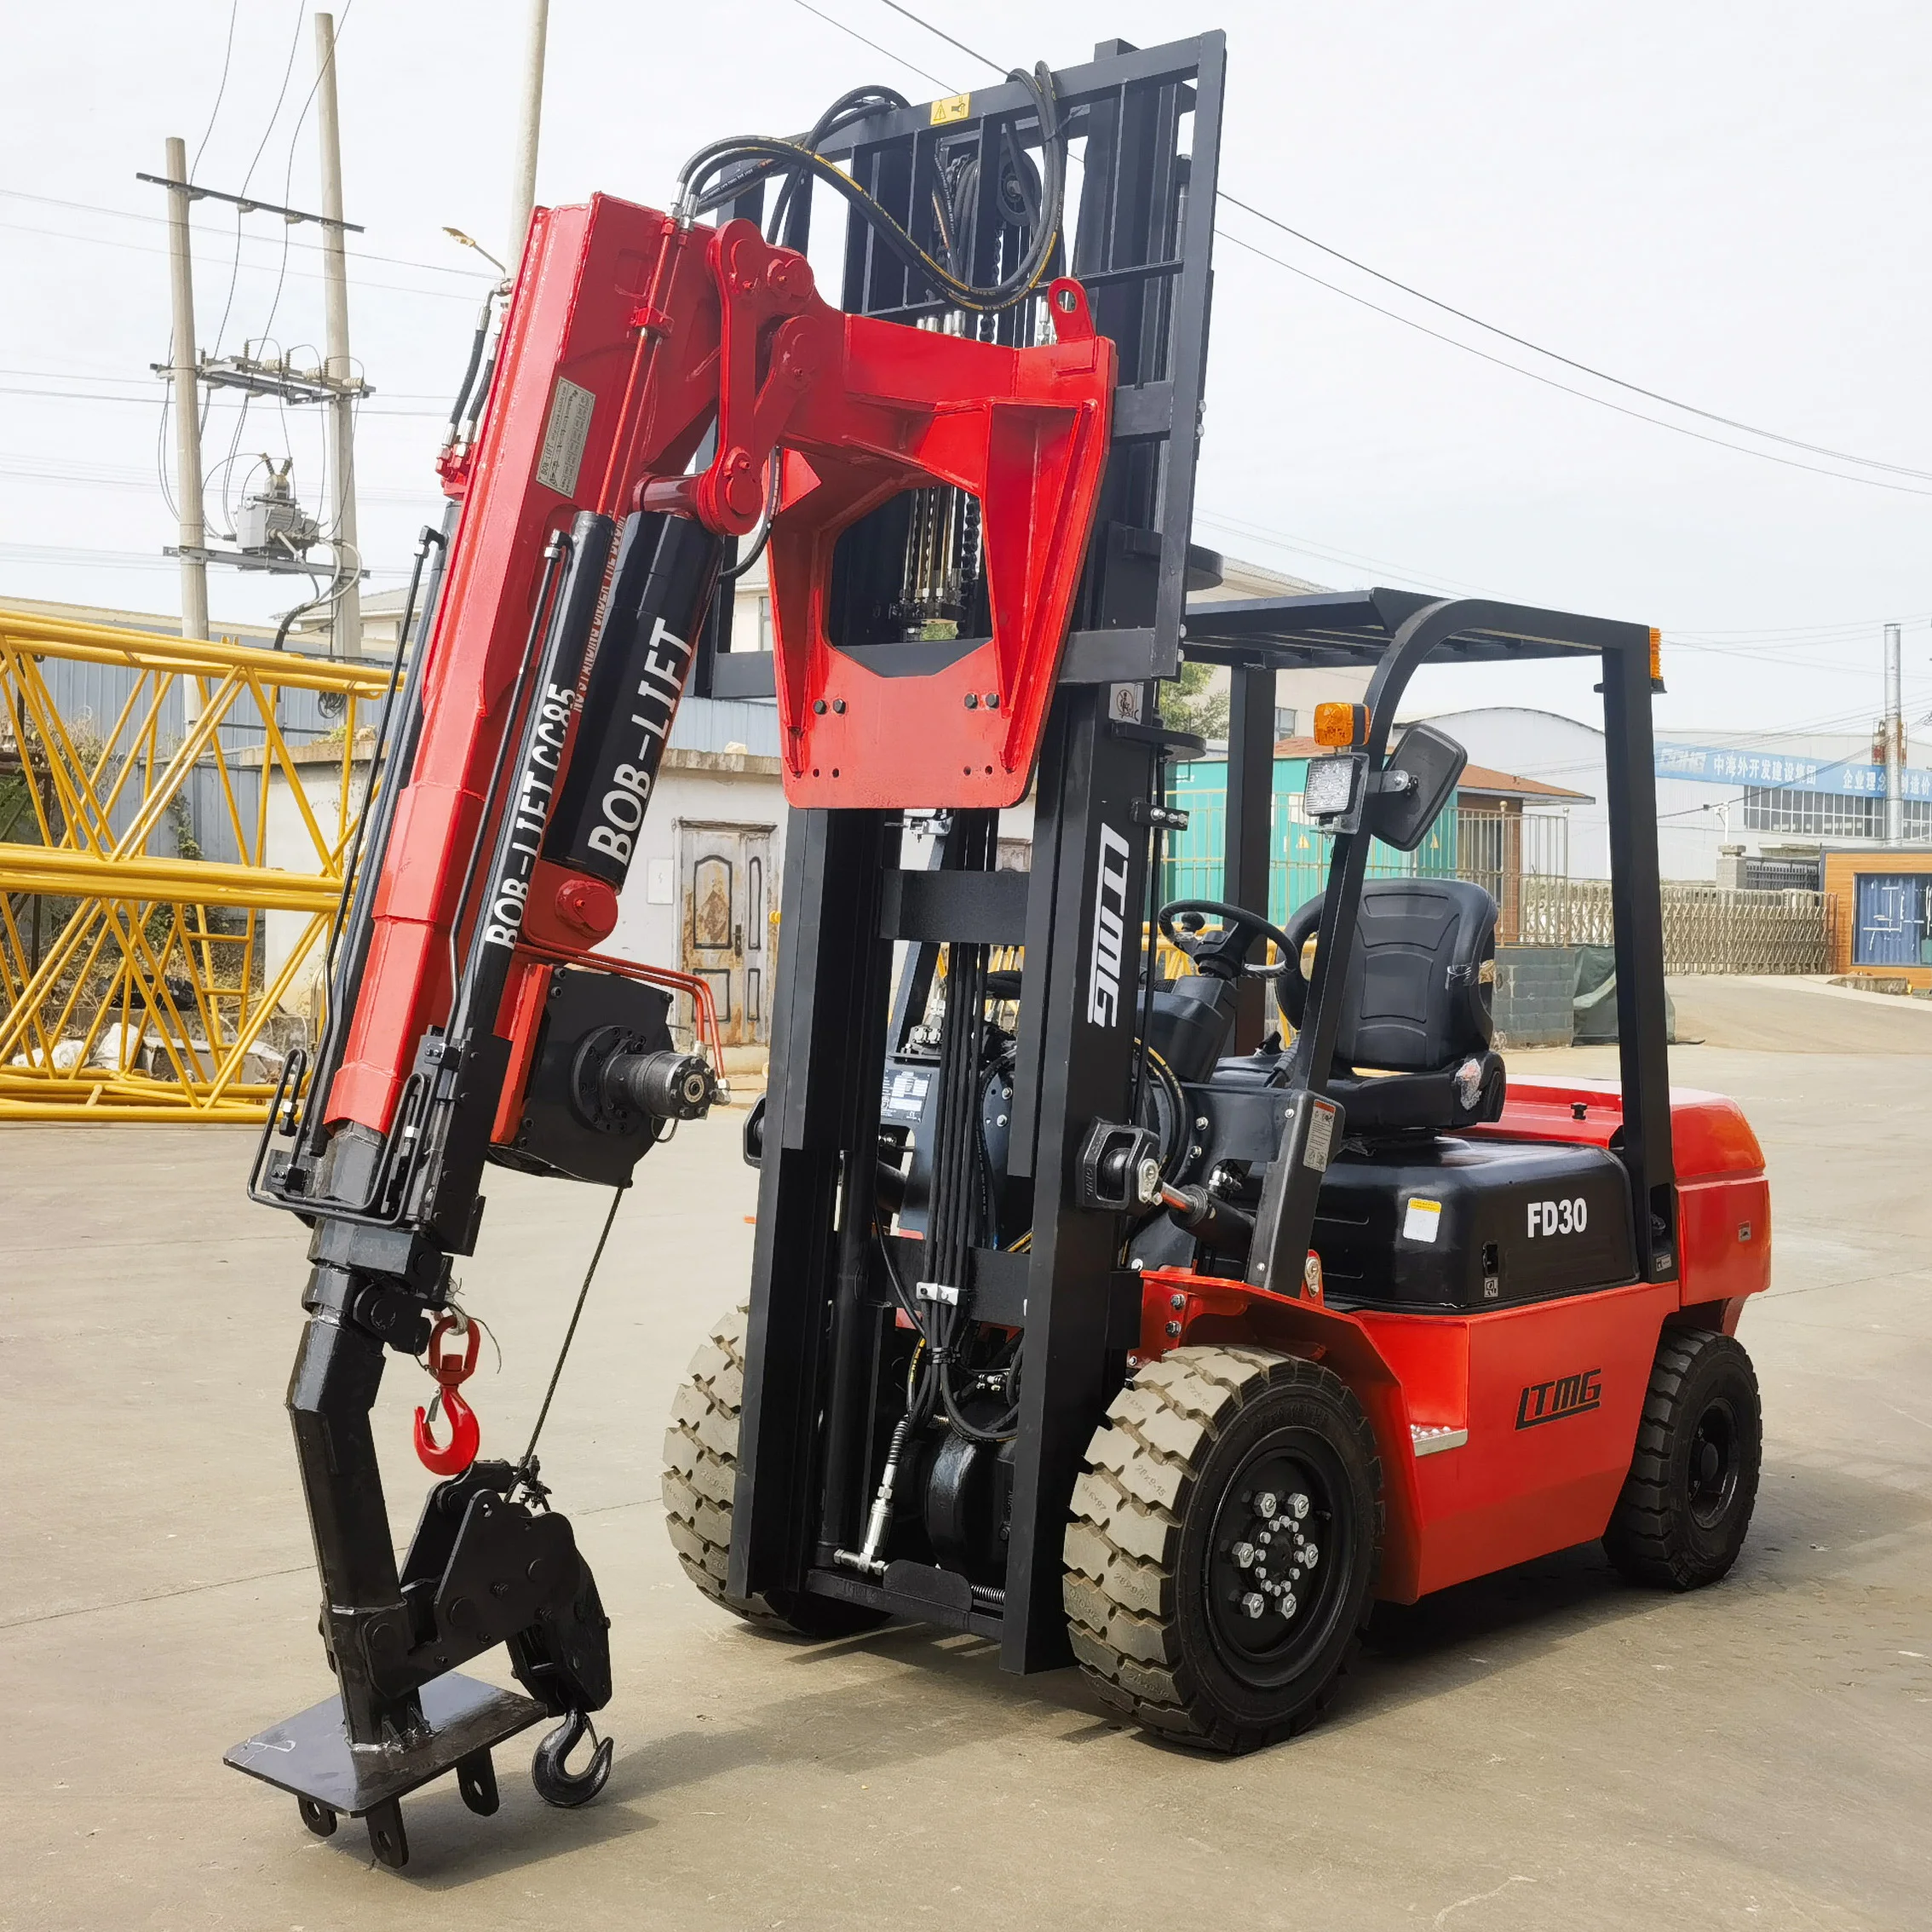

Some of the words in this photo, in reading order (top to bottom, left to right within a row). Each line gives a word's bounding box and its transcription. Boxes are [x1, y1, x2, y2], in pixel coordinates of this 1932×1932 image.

[485, 772, 552, 950] BOB-LIFT
[532, 684, 576, 771] CC85
[588, 617, 692, 865] BOB-LIFT
[1088, 823, 1130, 1027] LTMG
[1527, 1198, 1588, 1239] FD30
[1515, 1367, 1601, 1431] LTMG
